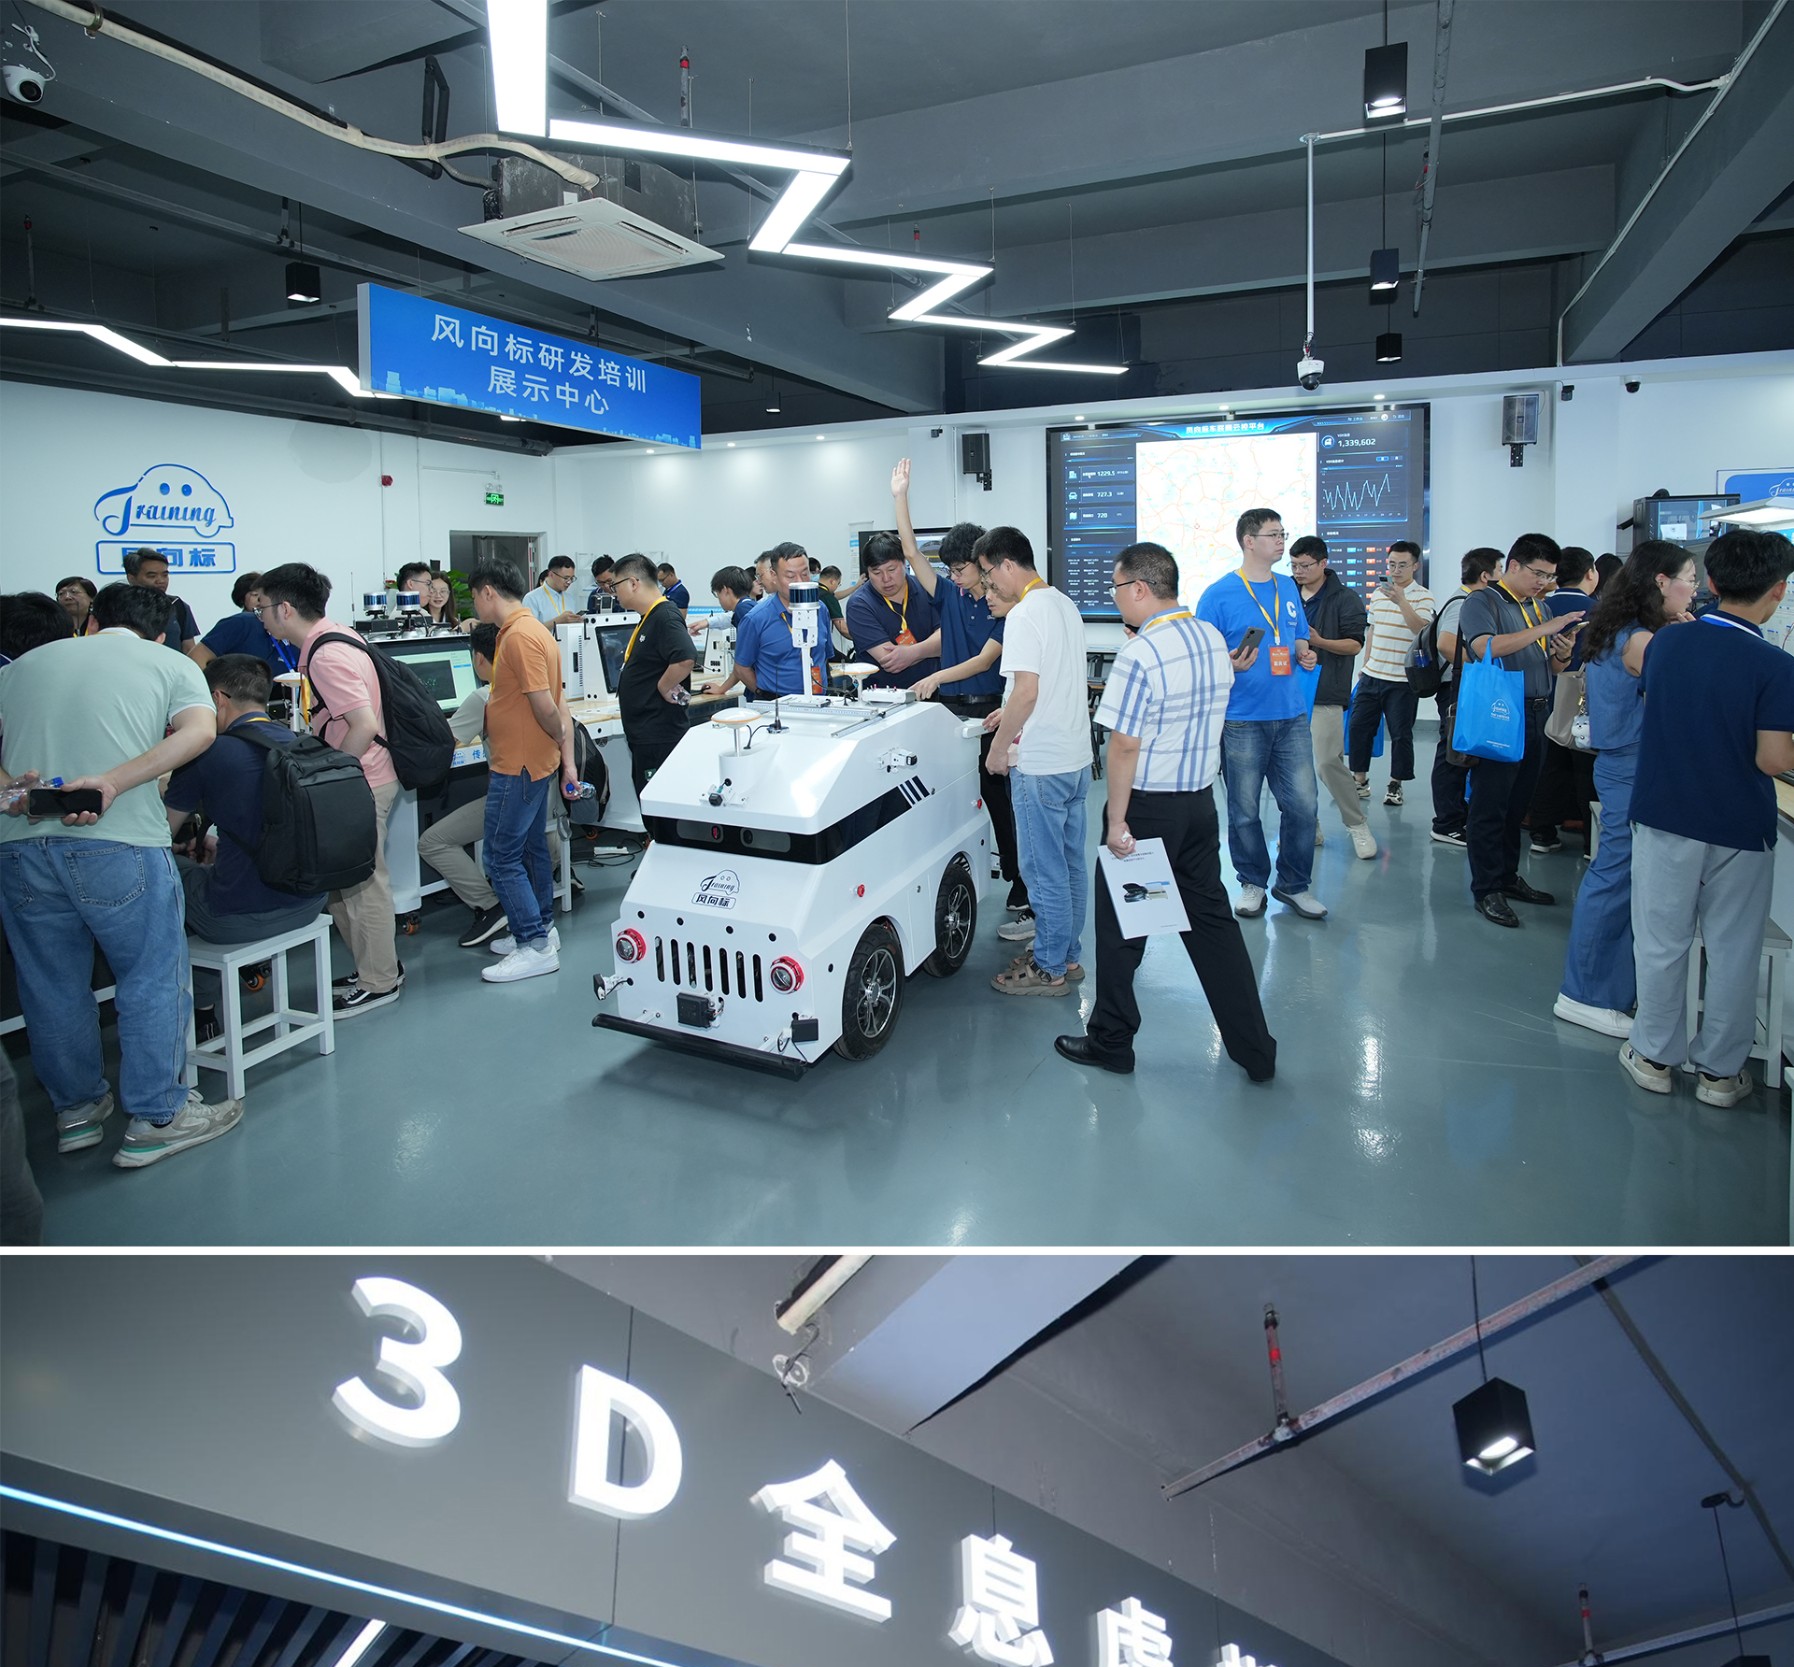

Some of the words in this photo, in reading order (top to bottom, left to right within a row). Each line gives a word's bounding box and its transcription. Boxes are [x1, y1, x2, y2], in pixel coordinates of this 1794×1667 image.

[431, 313, 647, 394] 风向标研发培训
[487, 365, 610, 416] 展示中心
[1337, 438, 1377, 447] 1,339,602
[94, 482, 217, 537] Training
[121, 547, 216, 568] 向标
[1286, 601, 1297, 618] C
[695, 893, 731, 907] 风向标
